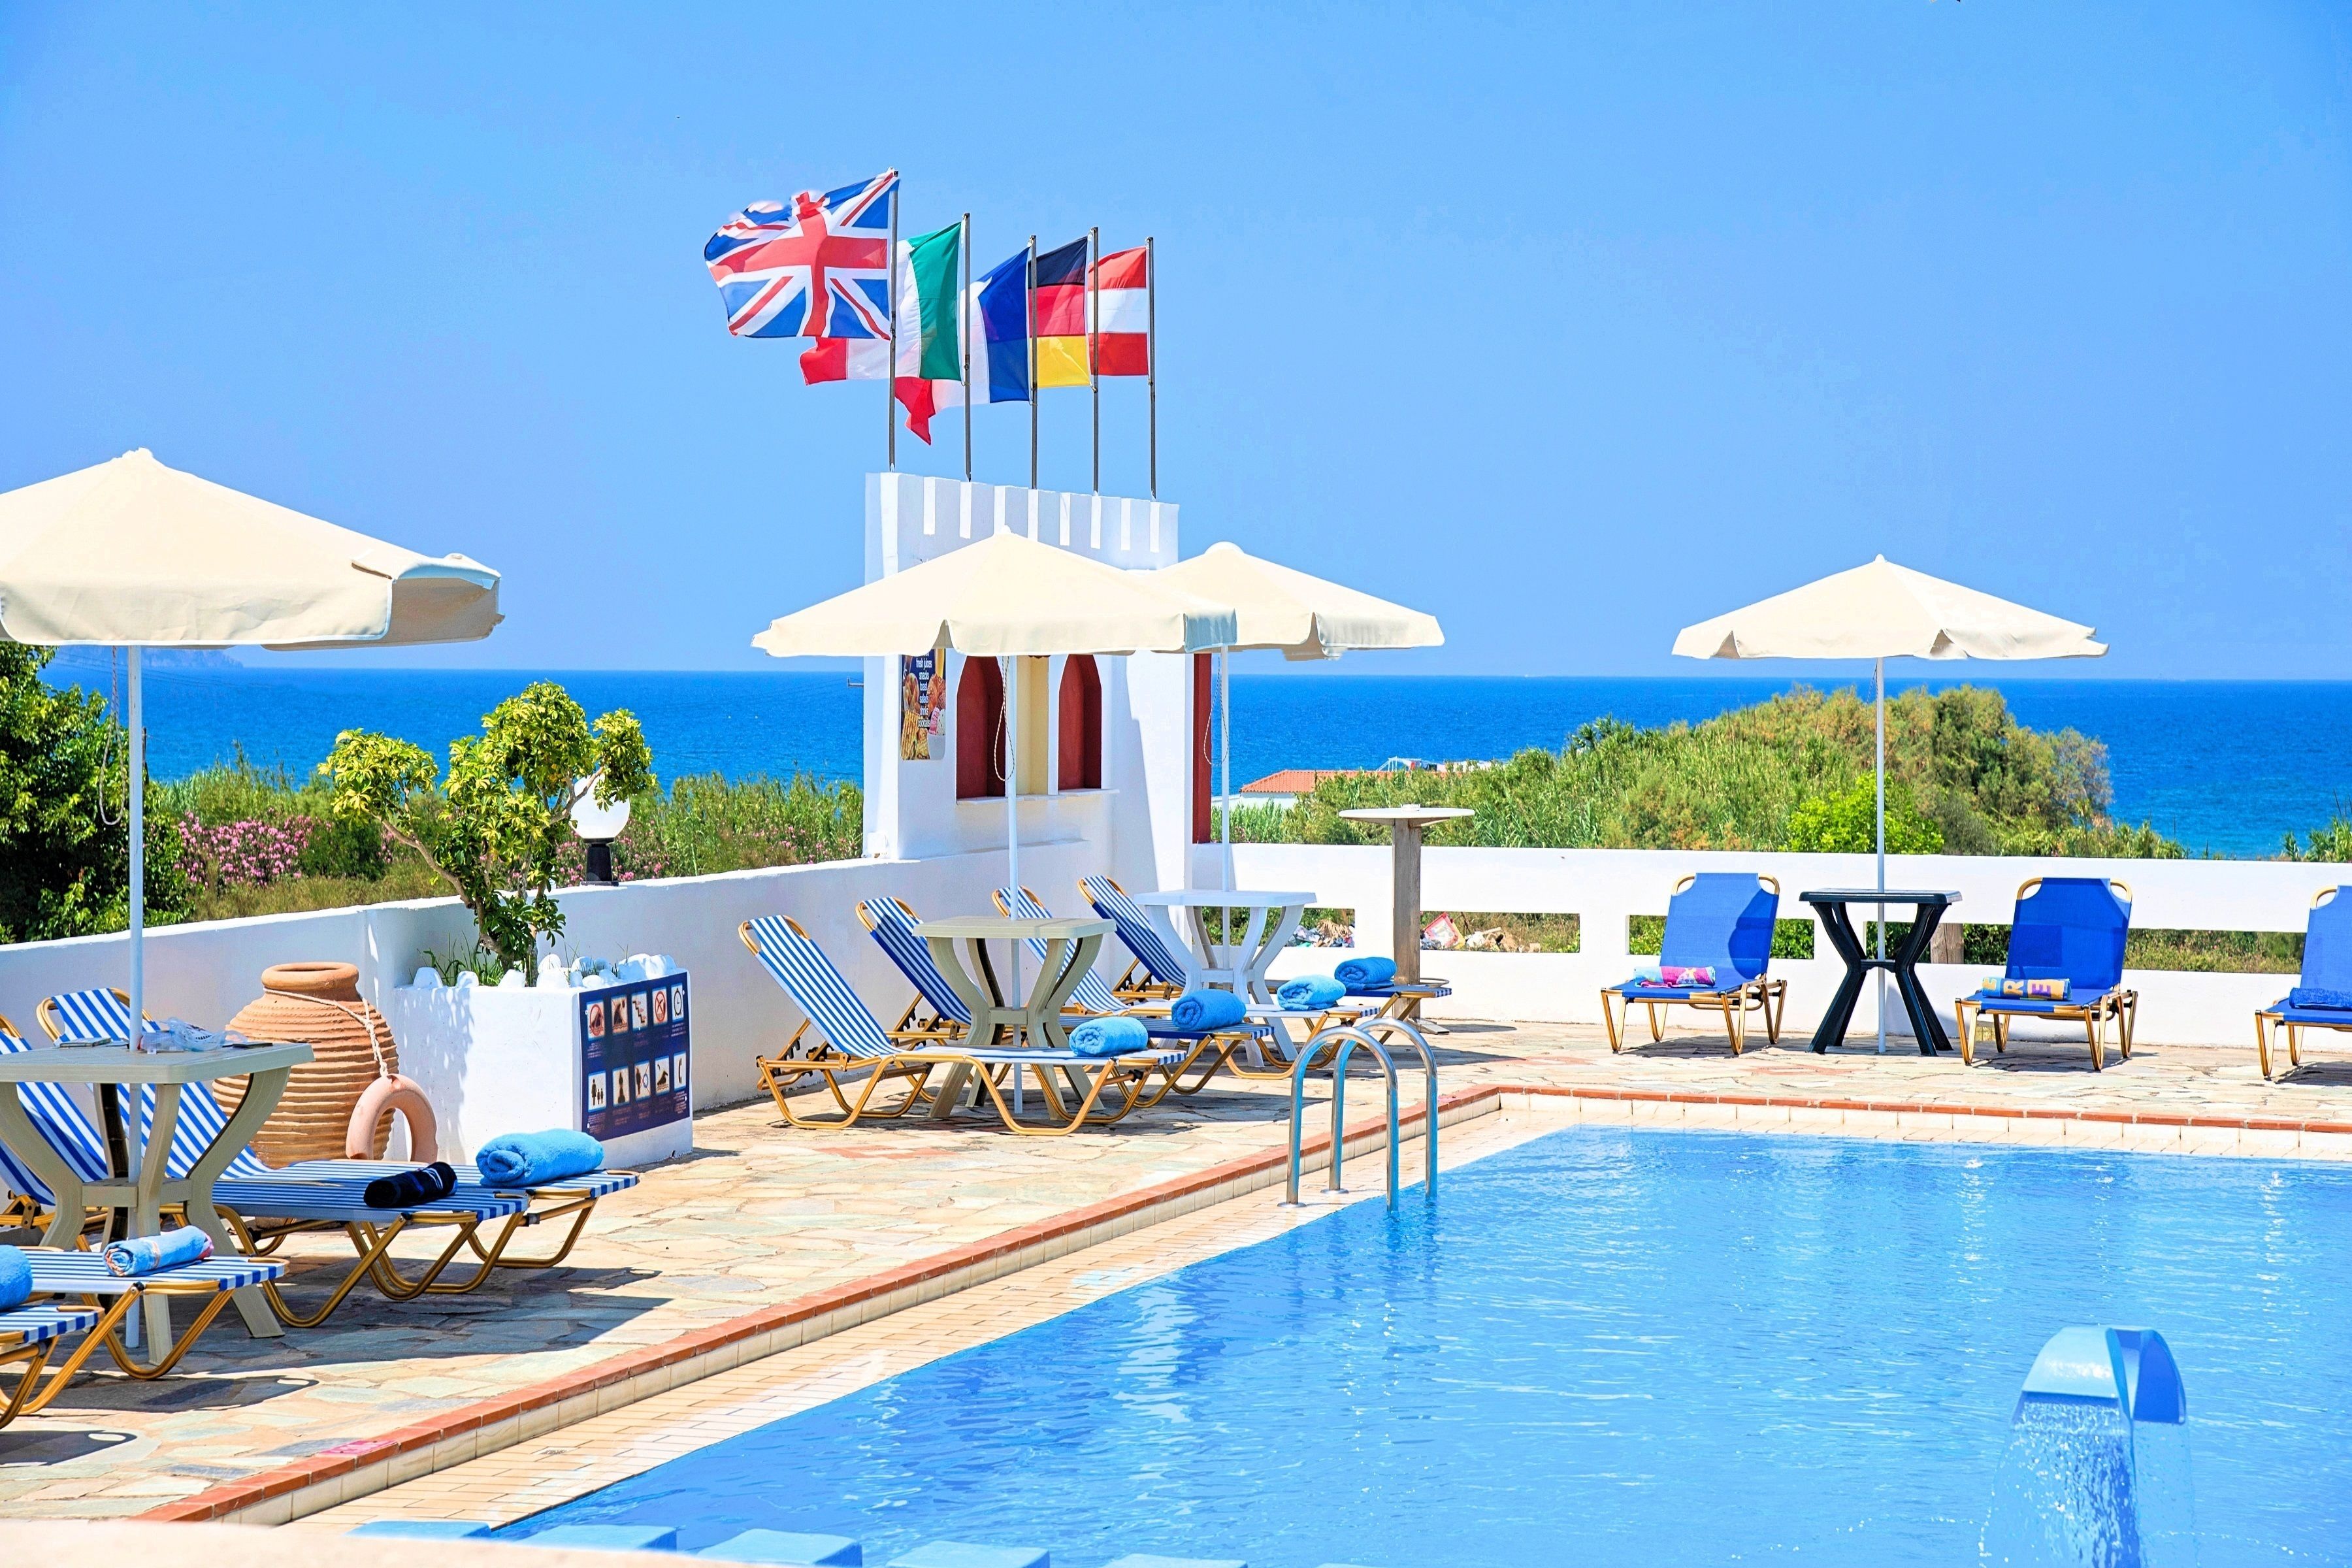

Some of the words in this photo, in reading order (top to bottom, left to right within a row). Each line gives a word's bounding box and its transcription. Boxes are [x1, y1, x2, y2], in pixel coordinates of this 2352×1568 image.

[923, 657, 932, 670] juices
[919, 670, 929, 680] snacks
[919, 693, 928, 704] salads
[919, 705, 928, 715] drinks
[917, 717, 930, 727] cocktails
